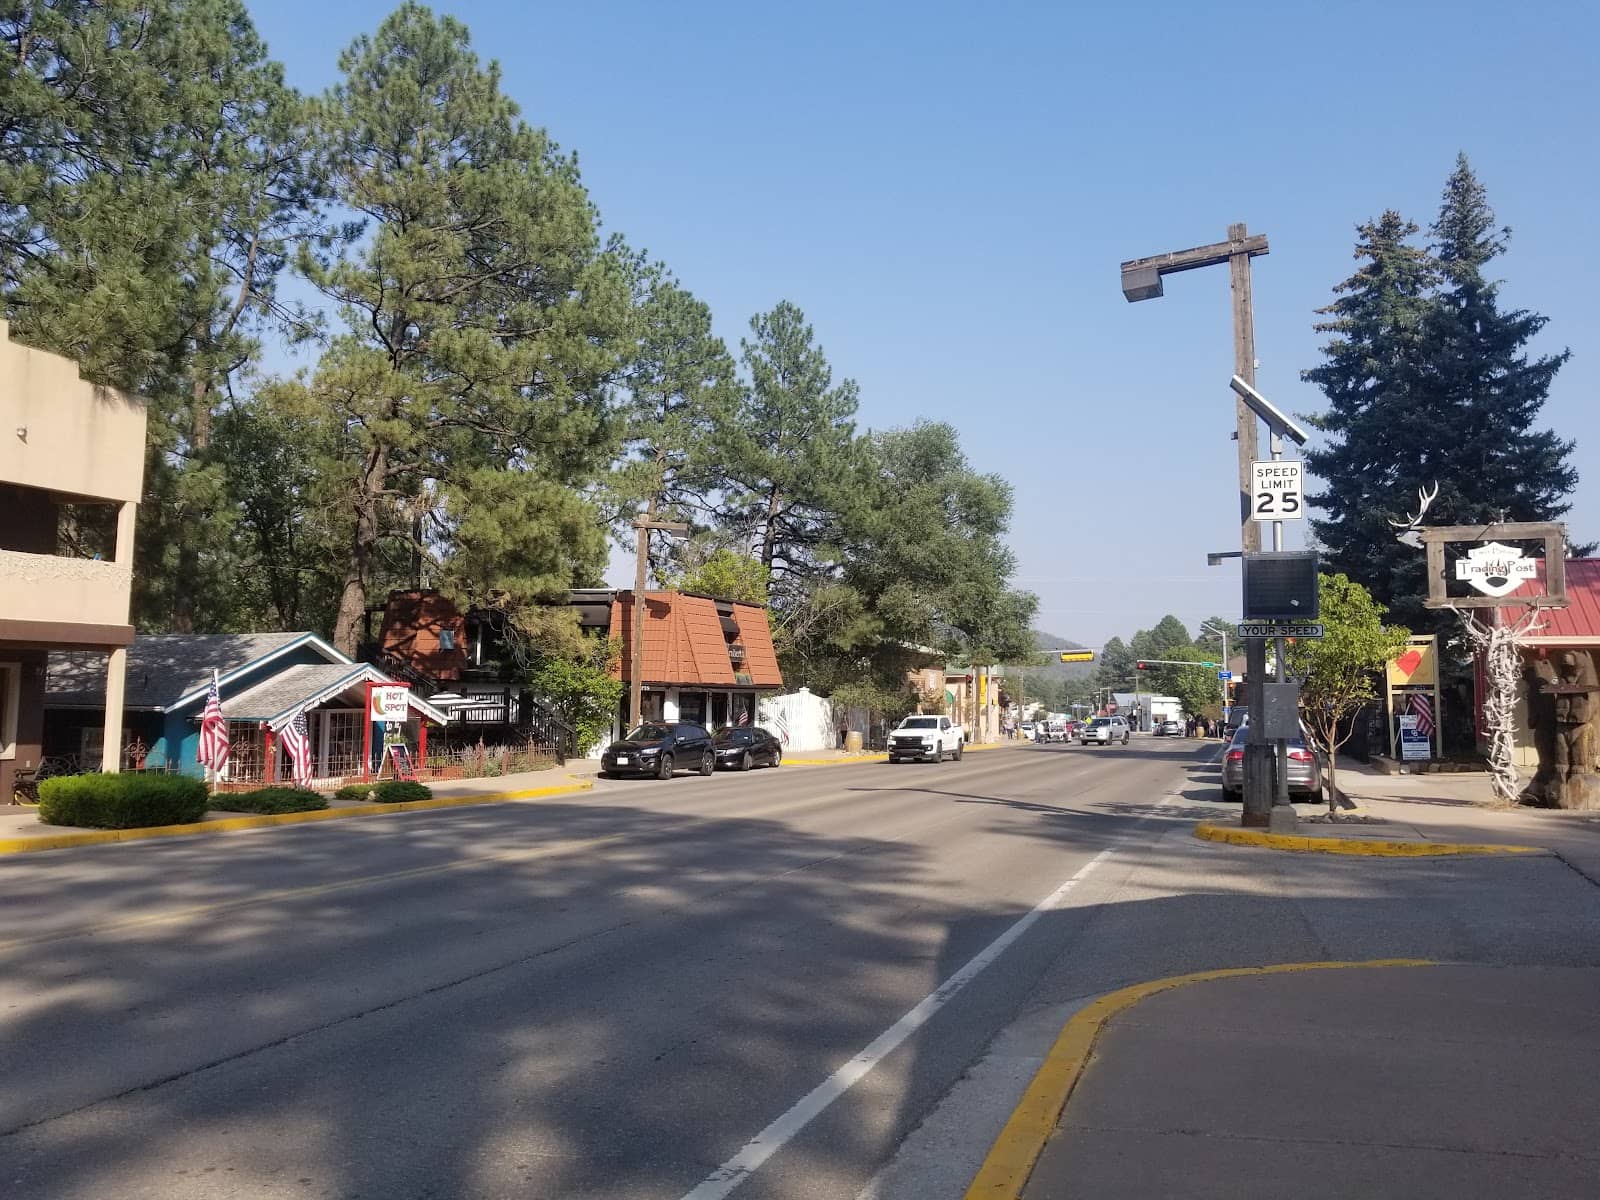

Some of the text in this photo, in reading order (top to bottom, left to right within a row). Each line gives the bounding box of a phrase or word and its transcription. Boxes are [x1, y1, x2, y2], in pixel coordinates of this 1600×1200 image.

[1256, 467, 1299, 478] SPEED
[1261, 479, 1295, 490] LIMIT
[1256, 492, 1300, 514] 25
[1457, 560, 1535, 577] Trading Post
[1243, 626, 1320, 636] YOUR SPEED
[385, 691, 405, 701] HOT
[384, 703, 407, 712] SPOT
